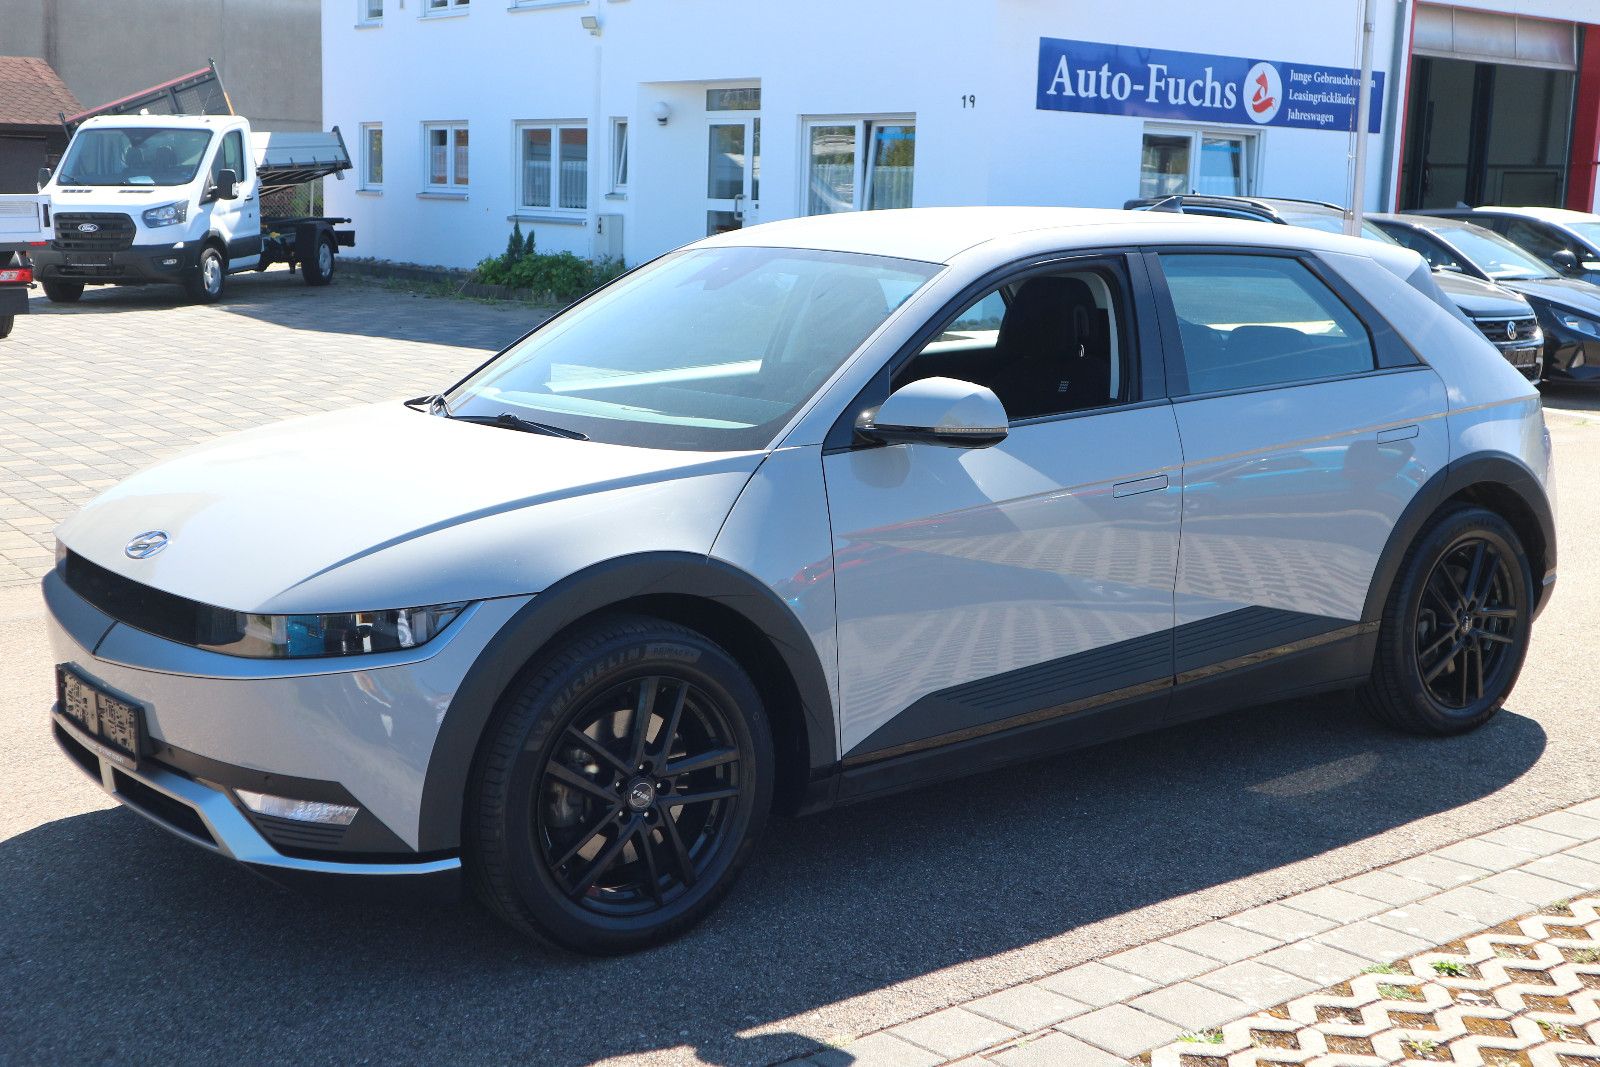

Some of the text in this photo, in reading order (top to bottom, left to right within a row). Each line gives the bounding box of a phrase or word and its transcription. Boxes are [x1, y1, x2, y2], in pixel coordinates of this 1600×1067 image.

[1046, 54, 1237, 110] Auto-Fuchs
[1289, 69, 1376, 89] Junge Gebrauchtwn
[961, 94, 976, 109] 19
[1288, 88, 1356, 105] Leasingrückläufer
[1287, 108, 1334, 125] Jahreswagen
[551, 648, 640, 717] MICHELIN
